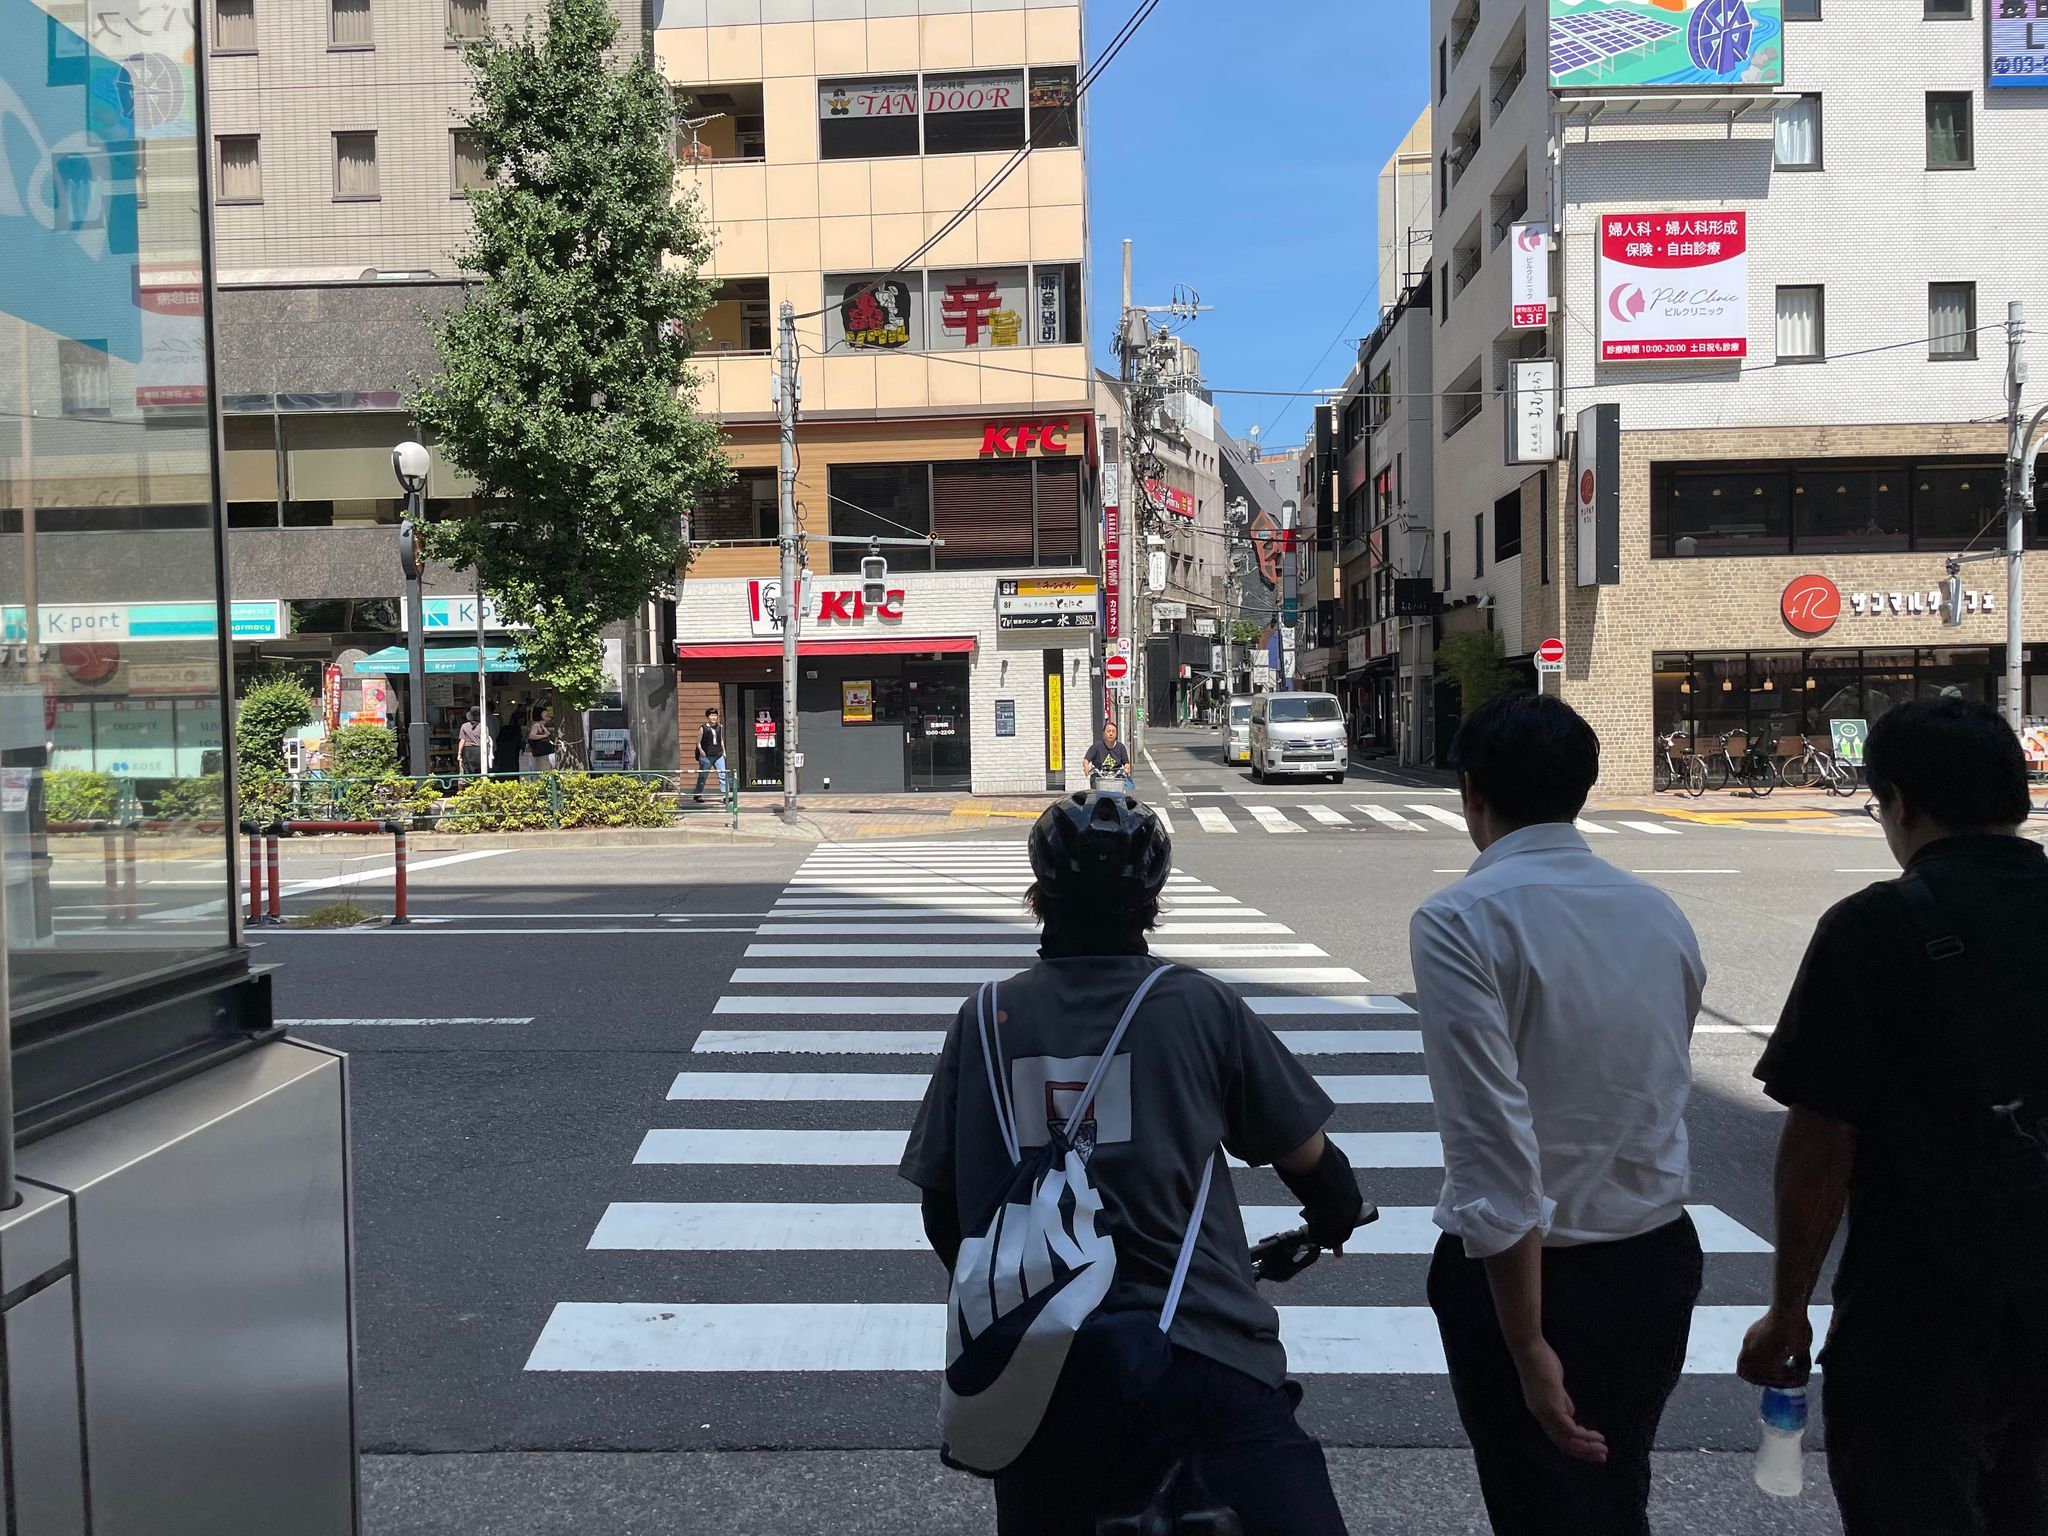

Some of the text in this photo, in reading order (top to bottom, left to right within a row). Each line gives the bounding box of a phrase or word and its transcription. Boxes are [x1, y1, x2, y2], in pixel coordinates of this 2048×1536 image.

[926, 87, 1010, 112] DOOR
[1608, 220, 1738, 237] 婦人科・婦人科形成
[1625, 242, 1721, 257] 保険・自由診療
[1650, 287, 1739, 310] Pill Clinic
[1526, 313, 1543, 324] 3F
[1606, 342, 1739, 355] 診療時間 10:00-20:00 土日祝も診療
[979, 421, 1070, 453] KFC
[1108, 513, 1117, 544] KARAOKE
[1003, 582, 1017, 595] 9F
[1003, 601, 1011, 609] 8F
[48, 612, 120, 634] K-port
[1109, 599, 1118, 634] カラオケ
